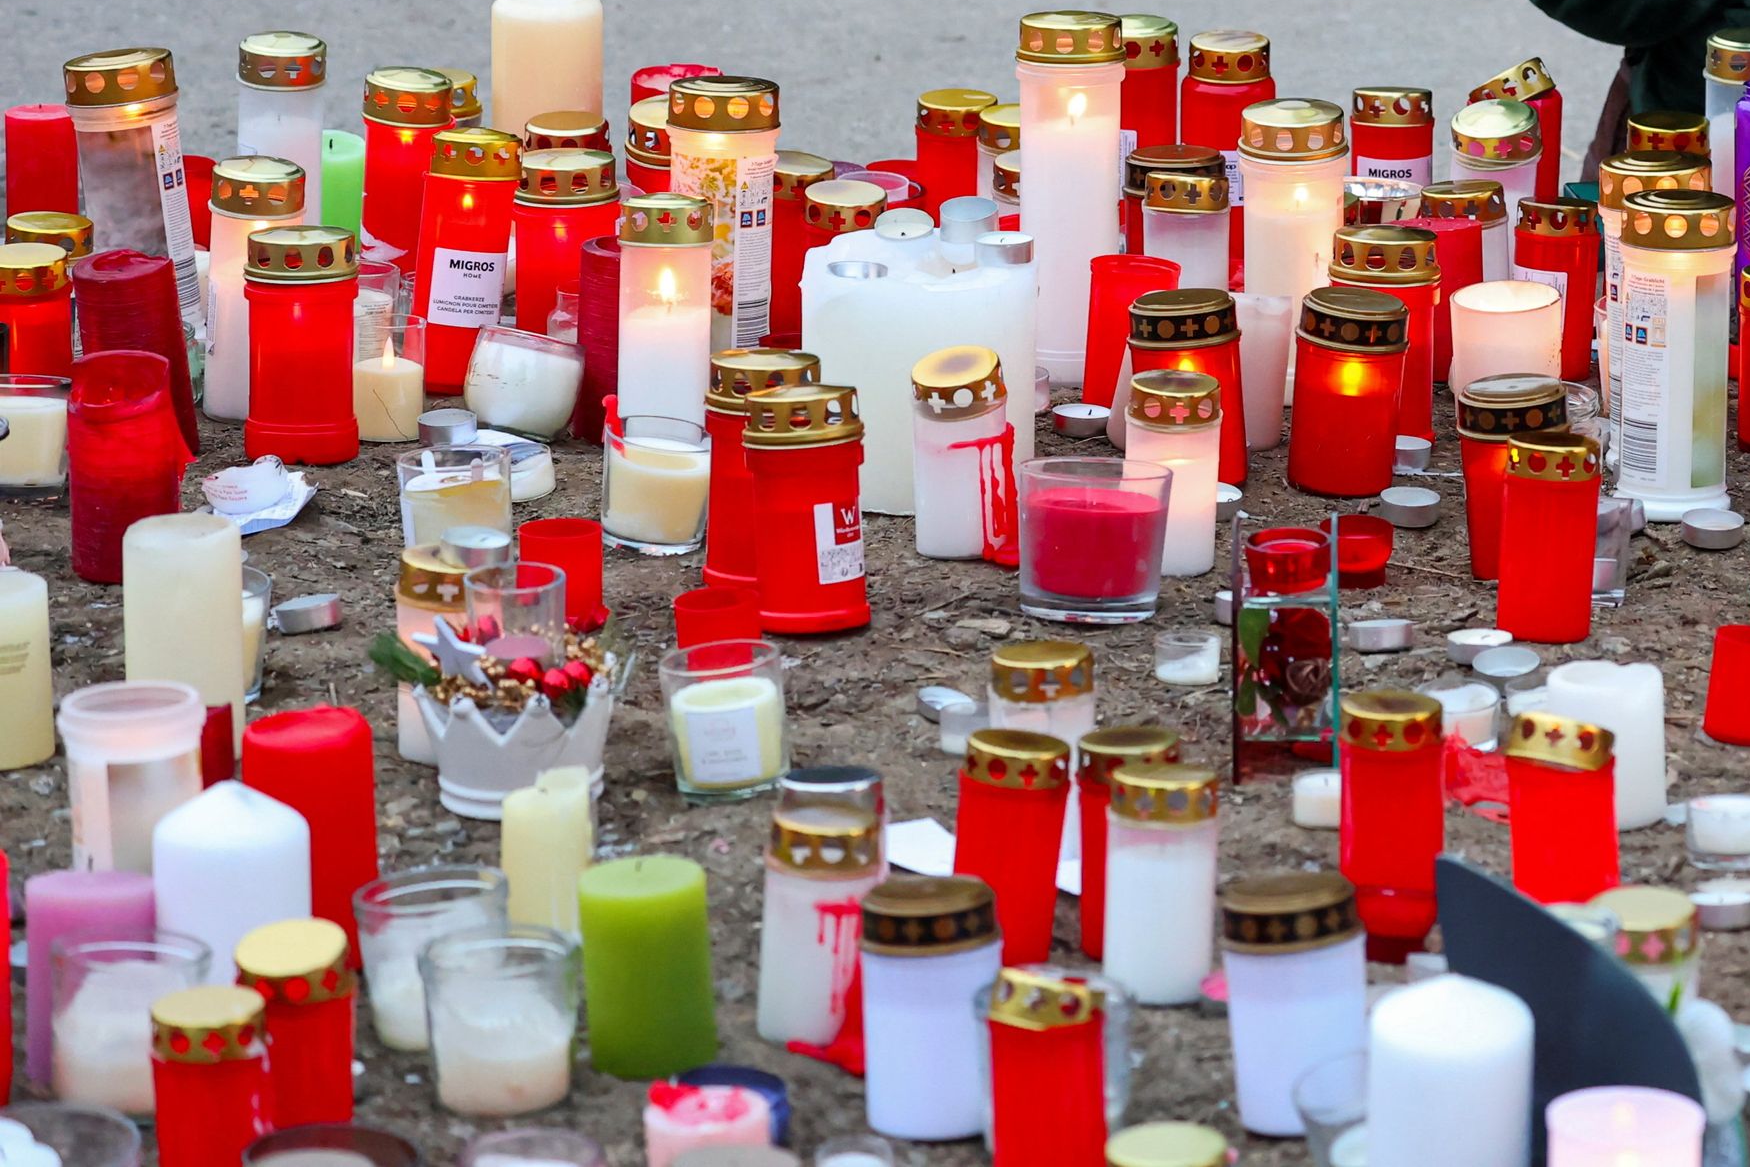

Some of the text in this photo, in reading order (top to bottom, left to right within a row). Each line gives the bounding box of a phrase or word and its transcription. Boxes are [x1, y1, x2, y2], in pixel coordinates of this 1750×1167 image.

[1368, 167, 1412, 179] MIGROS
[449, 258, 495, 272] MIGROS
[841, 506, 856, 525] W
